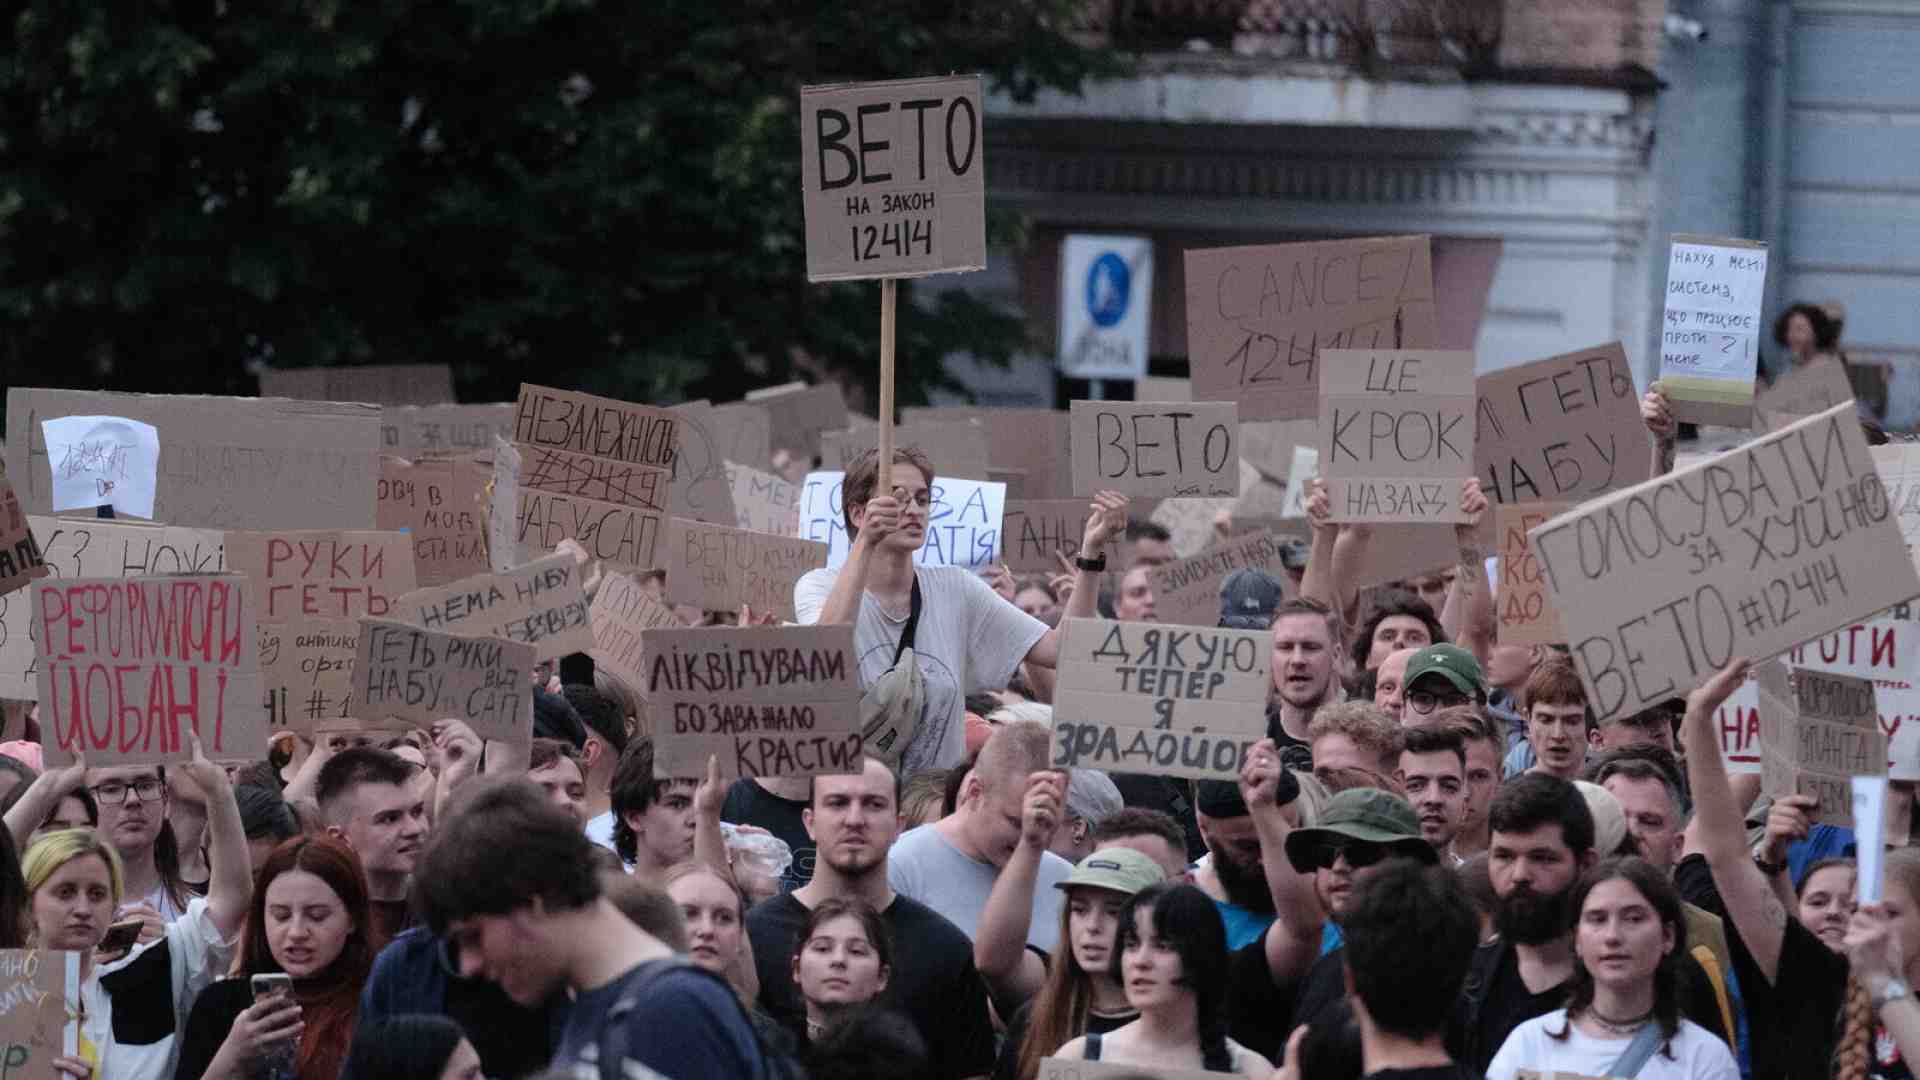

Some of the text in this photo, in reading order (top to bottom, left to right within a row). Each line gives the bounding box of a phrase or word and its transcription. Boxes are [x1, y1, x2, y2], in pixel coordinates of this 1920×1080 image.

[816, 95, 976, 191] ВЕТО
[846, 192, 936, 216] НА ЗАКОН
[852, 219, 932, 262] 12414
[1365, 358, 1422, 394] ЦЕ
[1517, 355, 1631, 425] ГЕТЬ
[1096, 412, 1230, 478] ВЕТО
[1331, 408, 1465, 463] КРОК
[1346, 482, 1448, 516] НАЗАД
[1537, 416, 1854, 593] ГОЛОСУВАТИ
[267, 539, 385, 577] РУКИ
[1689, 537, 1725, 574] ЗА
[268, 583, 390, 617] ГЕТЬ
[420, 583, 505, 627] НЕМА
[515, 565, 571, 602] НАБУ
[40, 580, 242, 667] РЕФОРМАТОРИ
[1576, 553, 1848, 720] ВЕТО #12414
[366, 625, 503, 670] ГЕТЬ РУКИ
[650, 644, 846, 692] ЛІКВІДУВАЛИ
[1092, 624, 1265, 676] ДЯКУЮ,
[47, 654, 226, 753] ЙОБАНІ
[366, 669, 443, 712] НАБУ
[1116, 667, 1226, 700] ТЕПЕР
[1154, 698, 1176, 730] Я
[735, 733, 865, 777] КРАСТИ?
